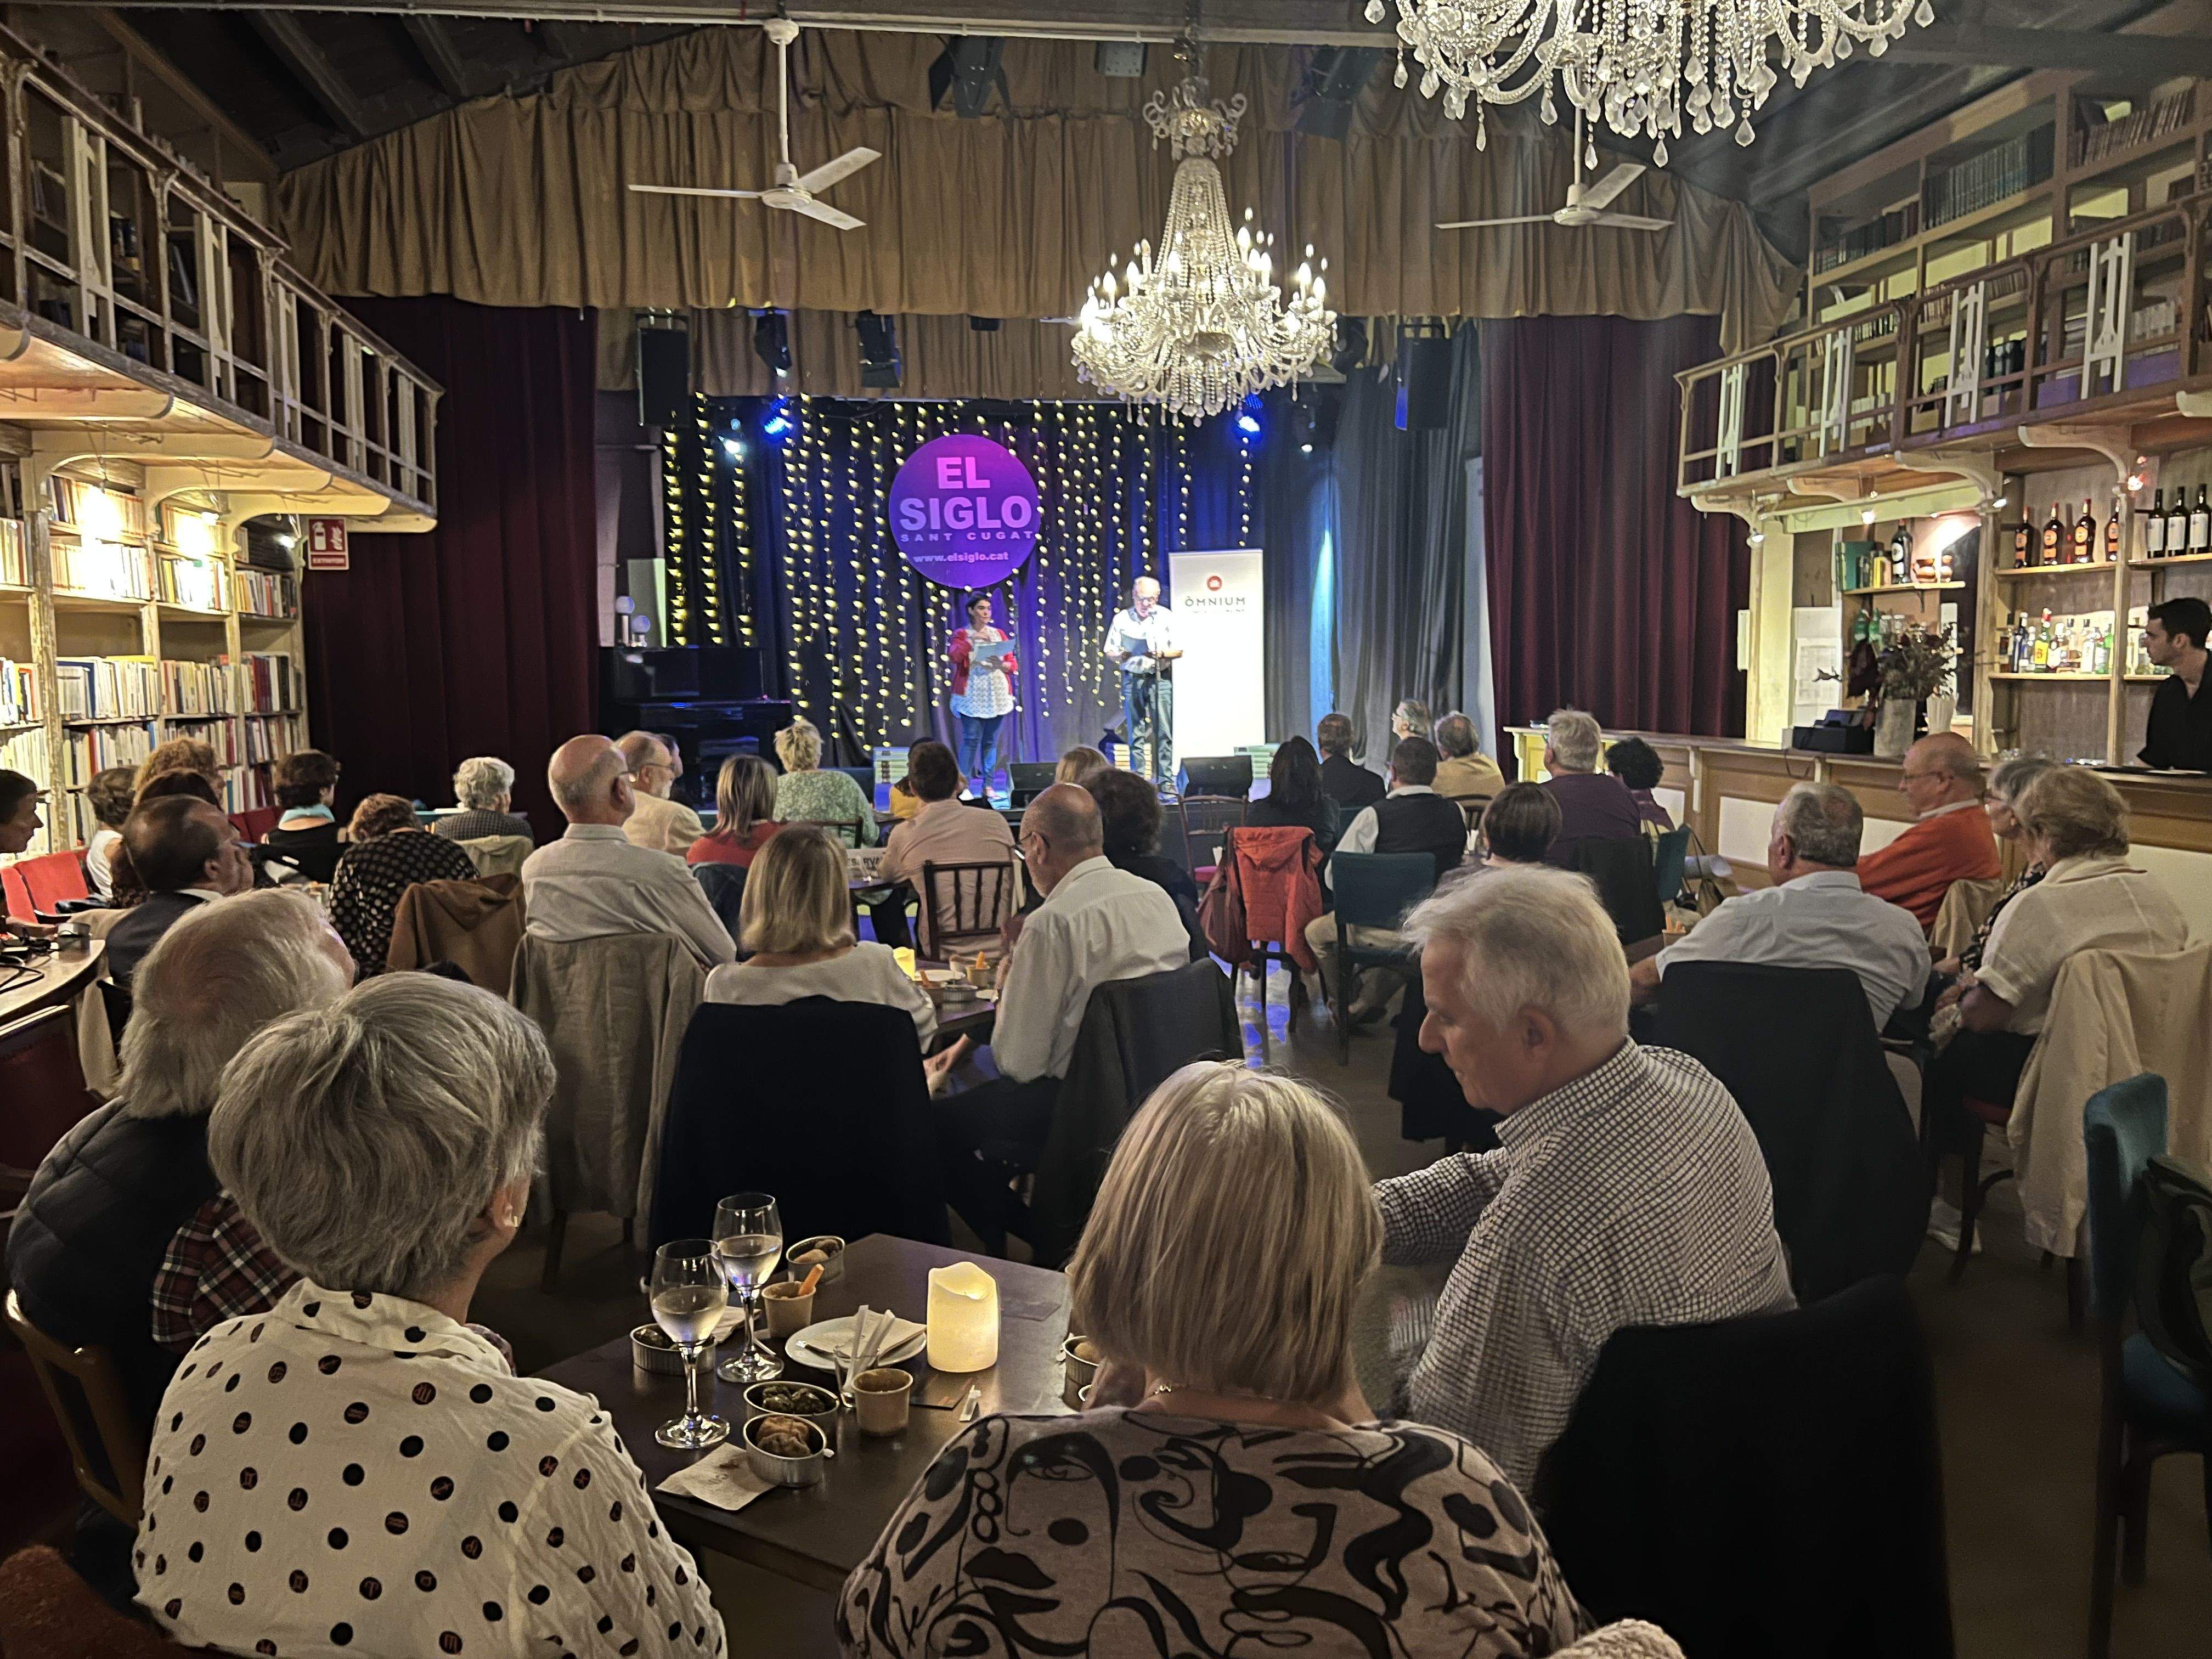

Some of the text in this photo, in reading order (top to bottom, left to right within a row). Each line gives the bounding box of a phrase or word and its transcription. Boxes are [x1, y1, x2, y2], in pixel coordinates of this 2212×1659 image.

[936, 456, 991, 489] EL
[899, 495, 1032, 531] SIGLO
[900, 531, 1033, 542] SANT CUGAT
[913, 551, 1009, 563] www.elsiglo.cat
[1184, 596, 1246, 607] ÒMNIUM
